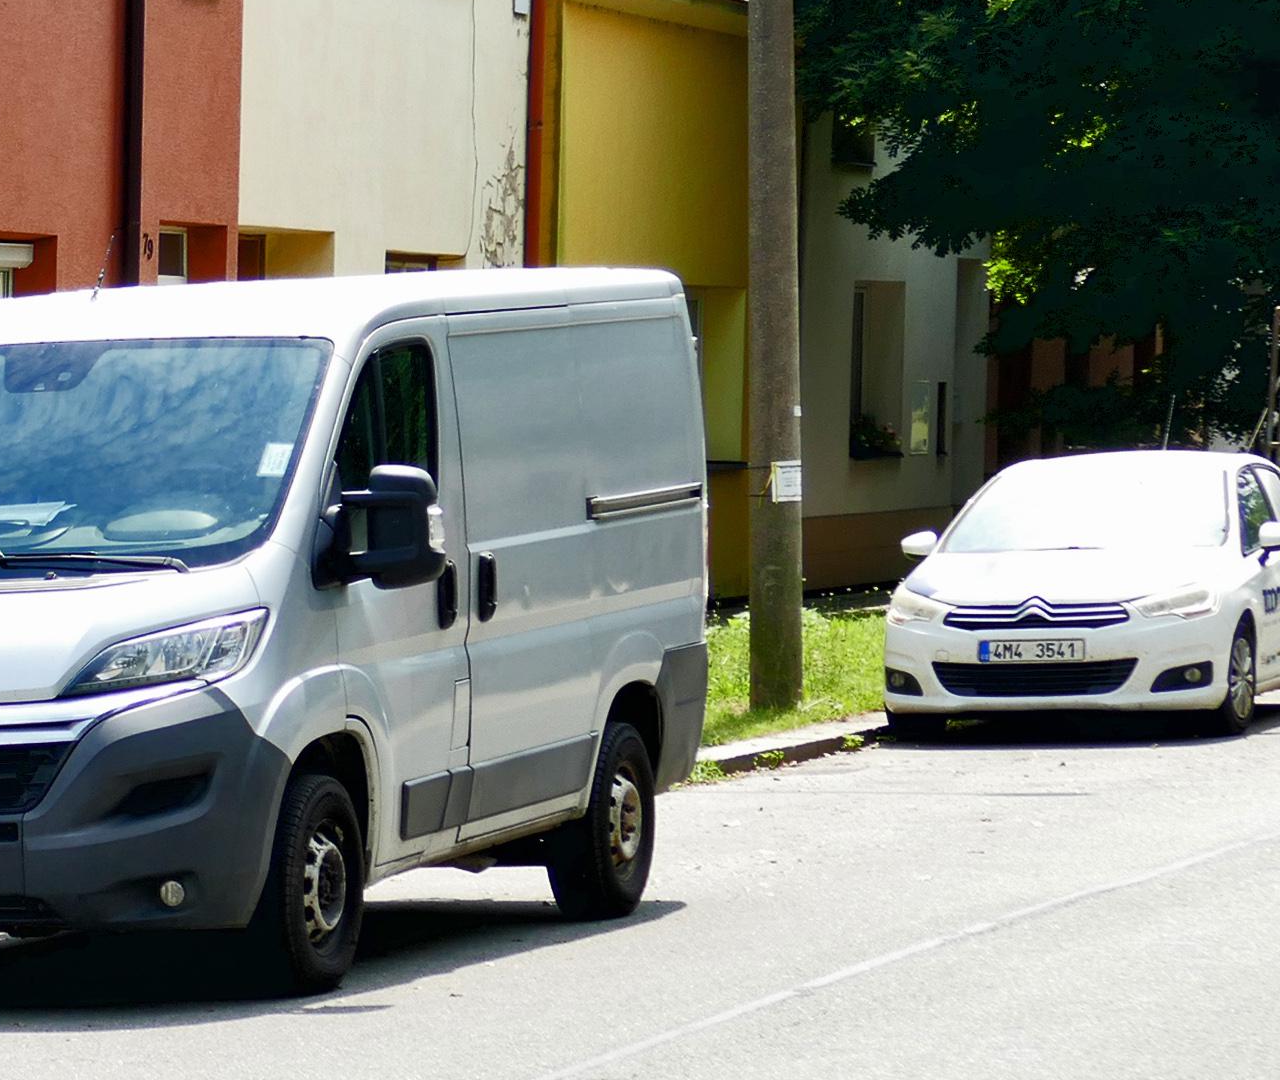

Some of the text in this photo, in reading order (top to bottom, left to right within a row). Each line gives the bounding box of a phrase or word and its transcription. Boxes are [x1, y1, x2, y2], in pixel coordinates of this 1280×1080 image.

[142, 232, 154, 261] 79
[993, 642, 1076, 659] 4M4 3541
